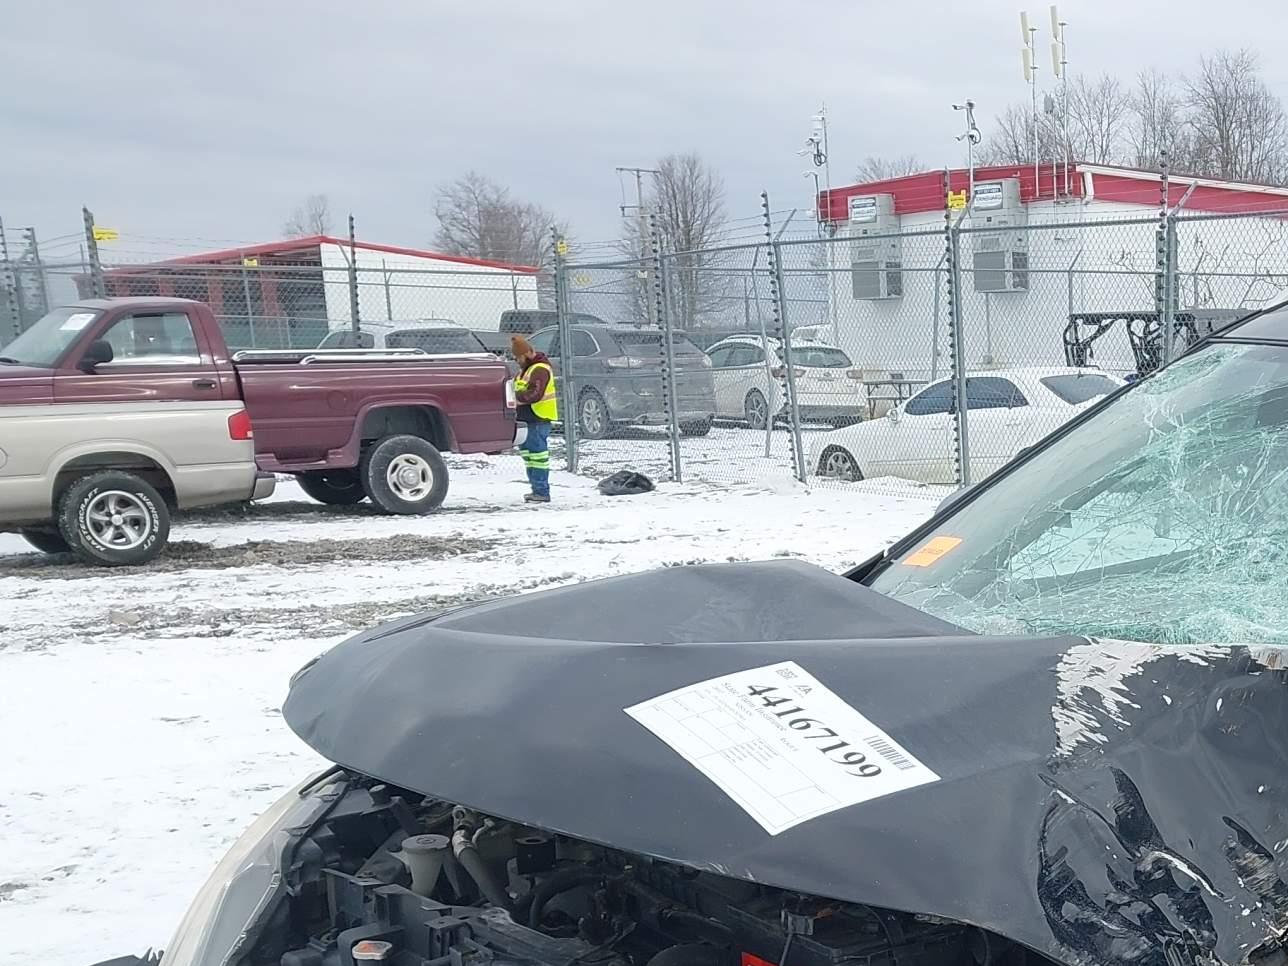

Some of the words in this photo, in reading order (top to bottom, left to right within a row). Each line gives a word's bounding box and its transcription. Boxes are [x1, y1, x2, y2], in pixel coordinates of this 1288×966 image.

[78, 488, 107, 552] MASTERCRAFT
[135, 492, 159, 533] AVENGER
[747, 683, 882, 778] 44167199
